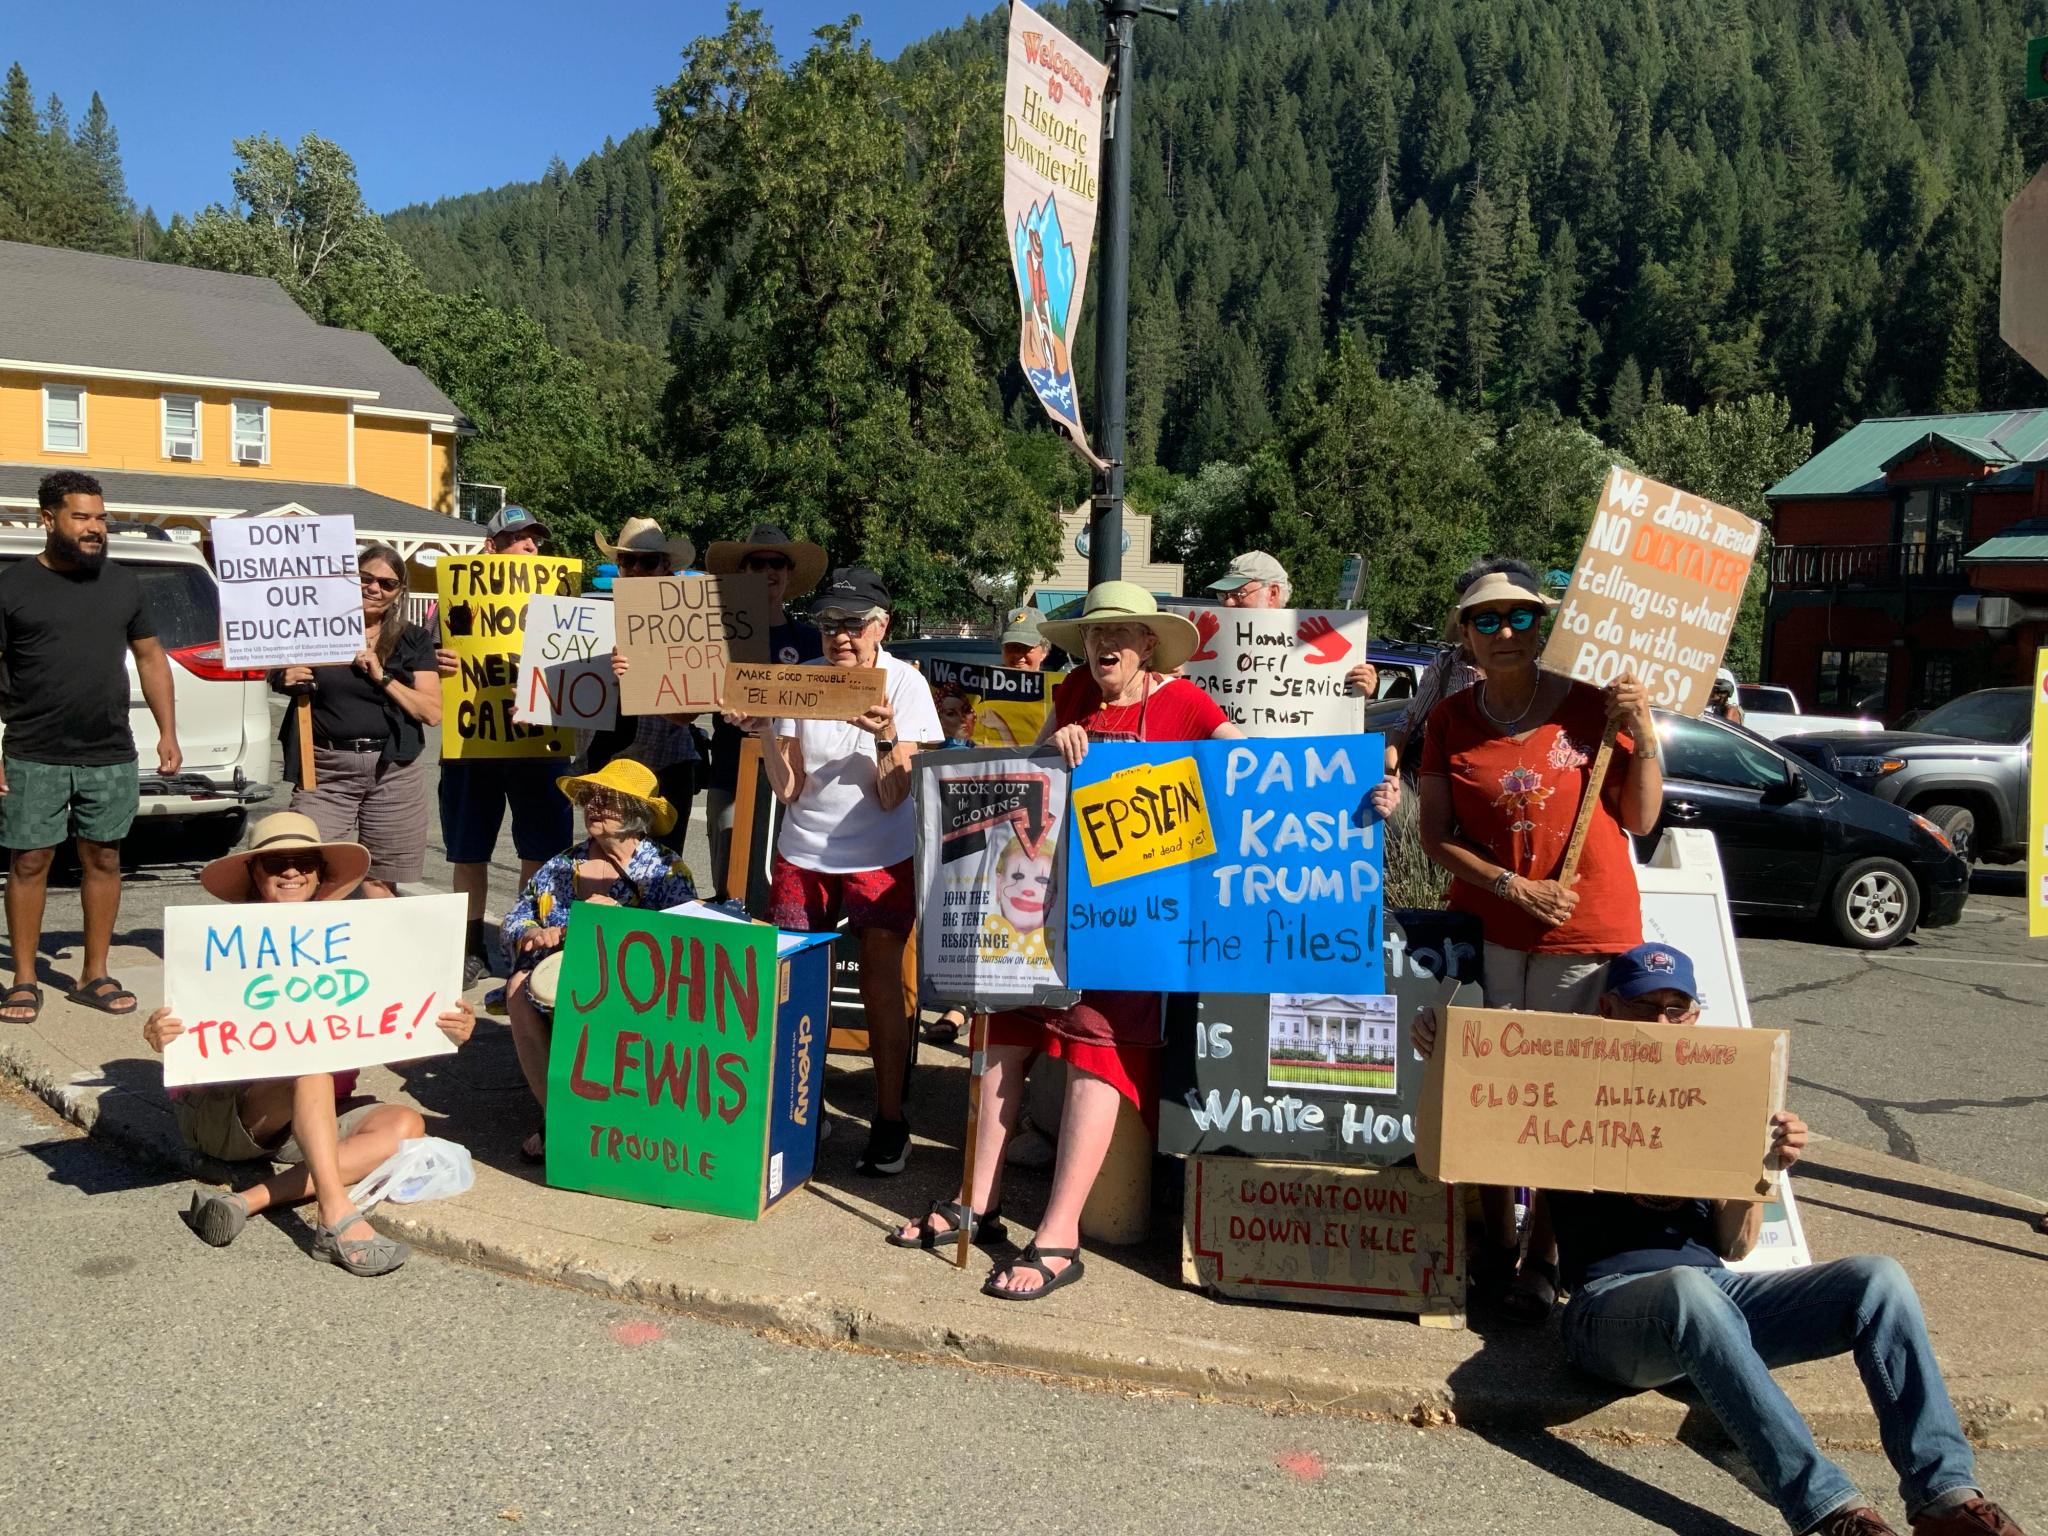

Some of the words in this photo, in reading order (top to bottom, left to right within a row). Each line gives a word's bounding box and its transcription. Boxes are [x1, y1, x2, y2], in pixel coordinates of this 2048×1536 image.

[1022, 31, 1093, 107] Welcome
[1048, 75, 1064, 104] to
[1021, 84, 1087, 155] Historic
[1006, 115, 1095, 199] Downieville
[1608, 466, 1649, 518] We
[1653, 491, 1714, 540] don't
[1712, 521, 1758, 556] need
[249, 523, 321, 546] DON'T
[1589, 511, 1631, 556] NO
[219, 554, 357, 580] DISMANTLE
[449, 560, 572, 597] TRUMP'S
[266, 585, 319, 607] OUR
[659, 578, 727, 612] DUE
[225, 615, 363, 641] EDUCATION
[553, 604, 596, 634] WE
[627, 610, 754, 645] PROCESS
[1680, 596, 1732, 636] what
[541, 633, 599, 664] SAY
[1236, 621, 1295, 648] Hands
[1562, 599, 1590, 635] to
[1594, 608, 1623, 645] do
[1629, 626, 1677, 661] with
[1677, 646, 1716, 673] our
[667, 644, 726, 671] FOR
[529, 666, 607, 718] NO
[777, 671, 802, 682] GOOD
[933, 661, 957, 683] We
[960, 666, 989, 689] Can
[992, 669, 1017, 692] Do
[1021, 673, 1040, 694] It!
[1182, 674, 1258, 695] OREST
[948, 782, 990, 796] KICK
[994, 782, 1029, 796] OUT
[1225, 746, 1356, 797] PAM
[952, 796, 1021, 828] CLOWNS
[958, 798, 970, 811] the
[1081, 776, 1202, 863] EPSTEIN
[1143, 849, 1156, 861] not
[1160, 840, 1183, 858] dead
[1188, 829, 1208, 850] yet
[1239, 808, 1374, 858] KASH
[943, 890, 967, 906] JOIN
[970, 890, 990, 906] THE
[1212, 860, 1379, 908] TRUMP
[942, 911, 958, 927] BIG
[961, 911, 988, 927] TENT
[1178, 920, 1242, 967] the
[1263, 904, 1377, 969] files!
[205, 922, 351, 972] MAKE
[941, 933, 1009, 950] RESISTANCE
[1382, 931, 1477, 979] tor
[835, 960, 845, 970] al
[847, 960, 860, 971] St
[1014, 955, 1024, 965] ON
[243, 968, 370, 1010] GOOD
[571, 924, 760, 1043] JOHN
[188, 991, 437, 1059] TROUBLE!
[1196, 1002, 1233, 1059] is
[1462, 1020, 1492, 1058] No
[569, 1023, 750, 1125] LEWIS
[793, 1014, 811, 1126] chewy
[1470, 1082, 1558, 1109] CLOSE
[1595, 1086, 1707, 1110] ALLIGATOR
[1183, 1087, 1325, 1134] White
[1341, 1100, 1417, 1144] Hou
[1517, 1115, 1663, 1150] ALCATRAZ
[590, 1124, 717, 1181] TROUBLE
[1240, 1180, 1409, 1215] DOWNTOWN
